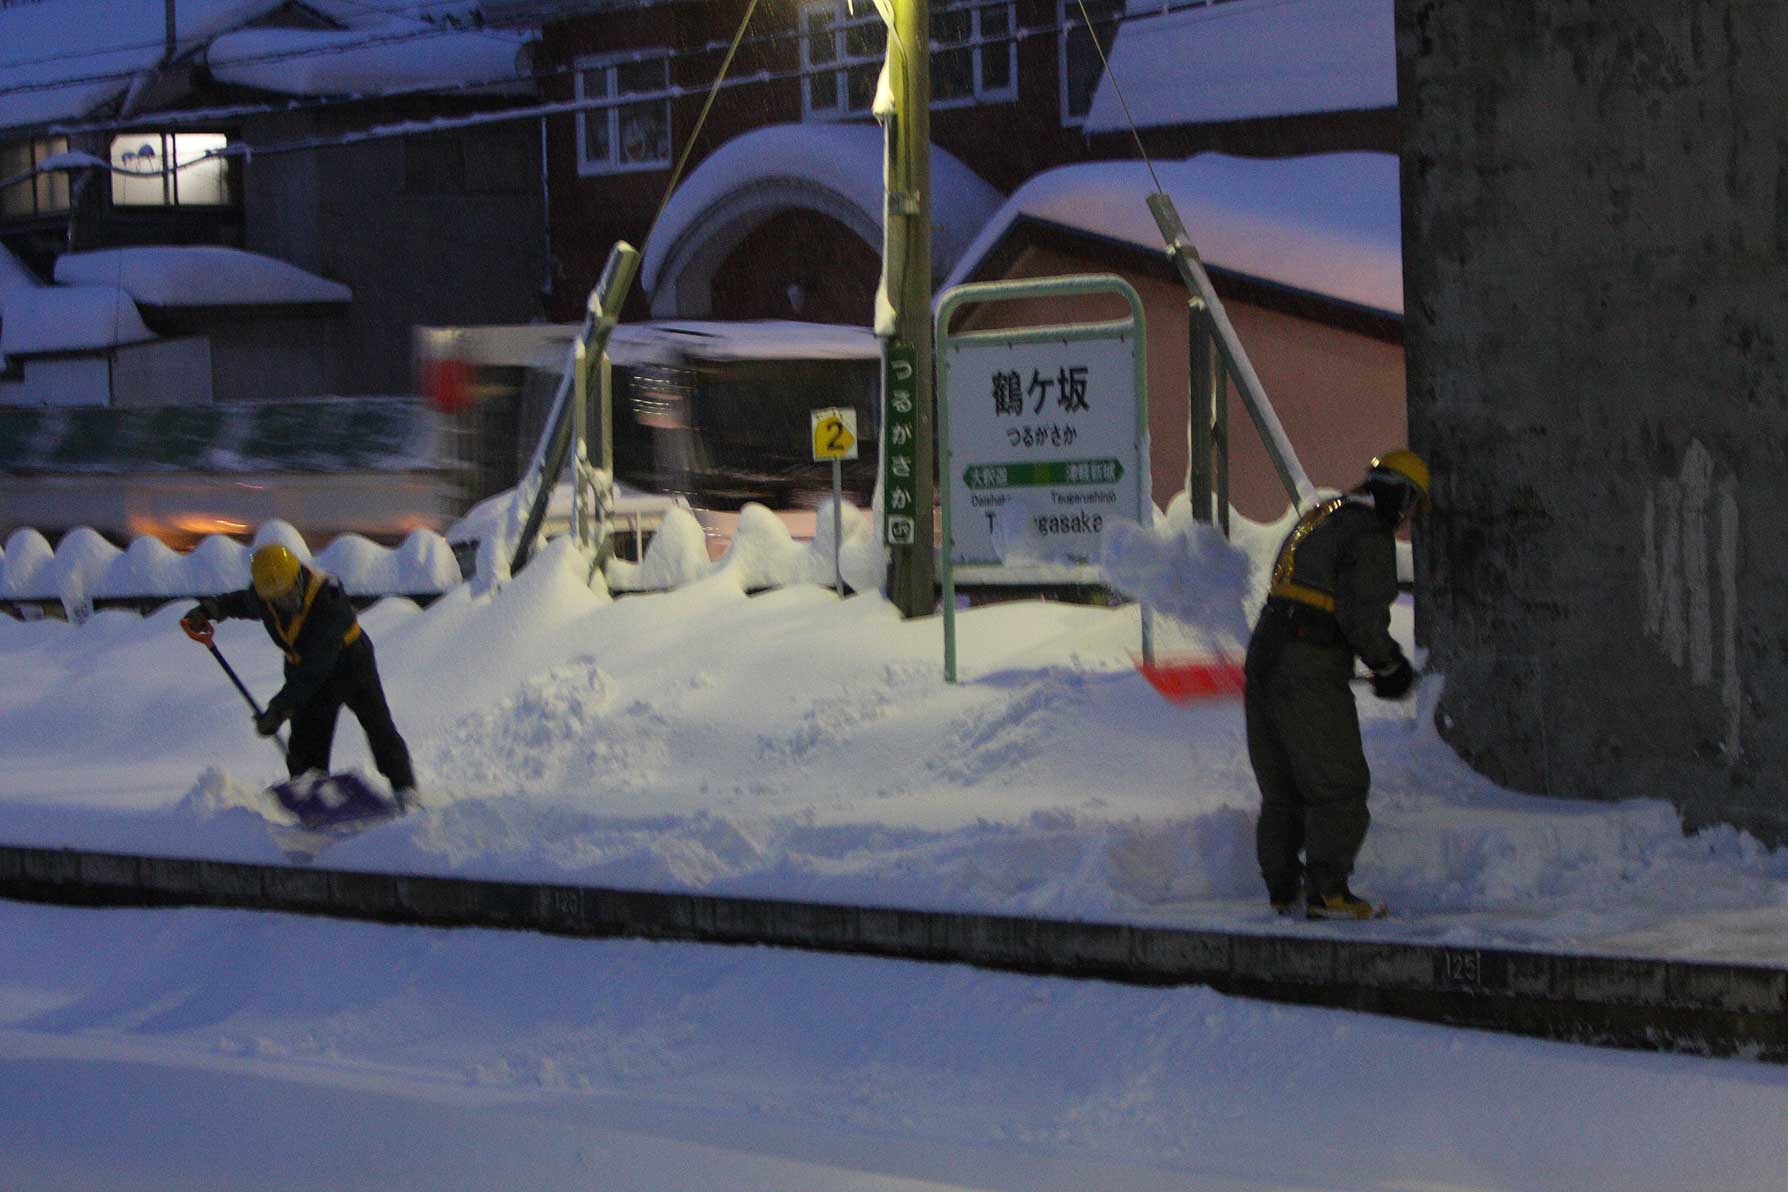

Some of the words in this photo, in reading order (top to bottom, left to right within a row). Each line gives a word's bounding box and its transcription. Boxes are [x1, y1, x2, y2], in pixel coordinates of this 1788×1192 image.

[826, 421, 845, 452] 2
[891, 360, 913, 510] つるがさか
[1007, 423, 1078, 448] つるがさか
